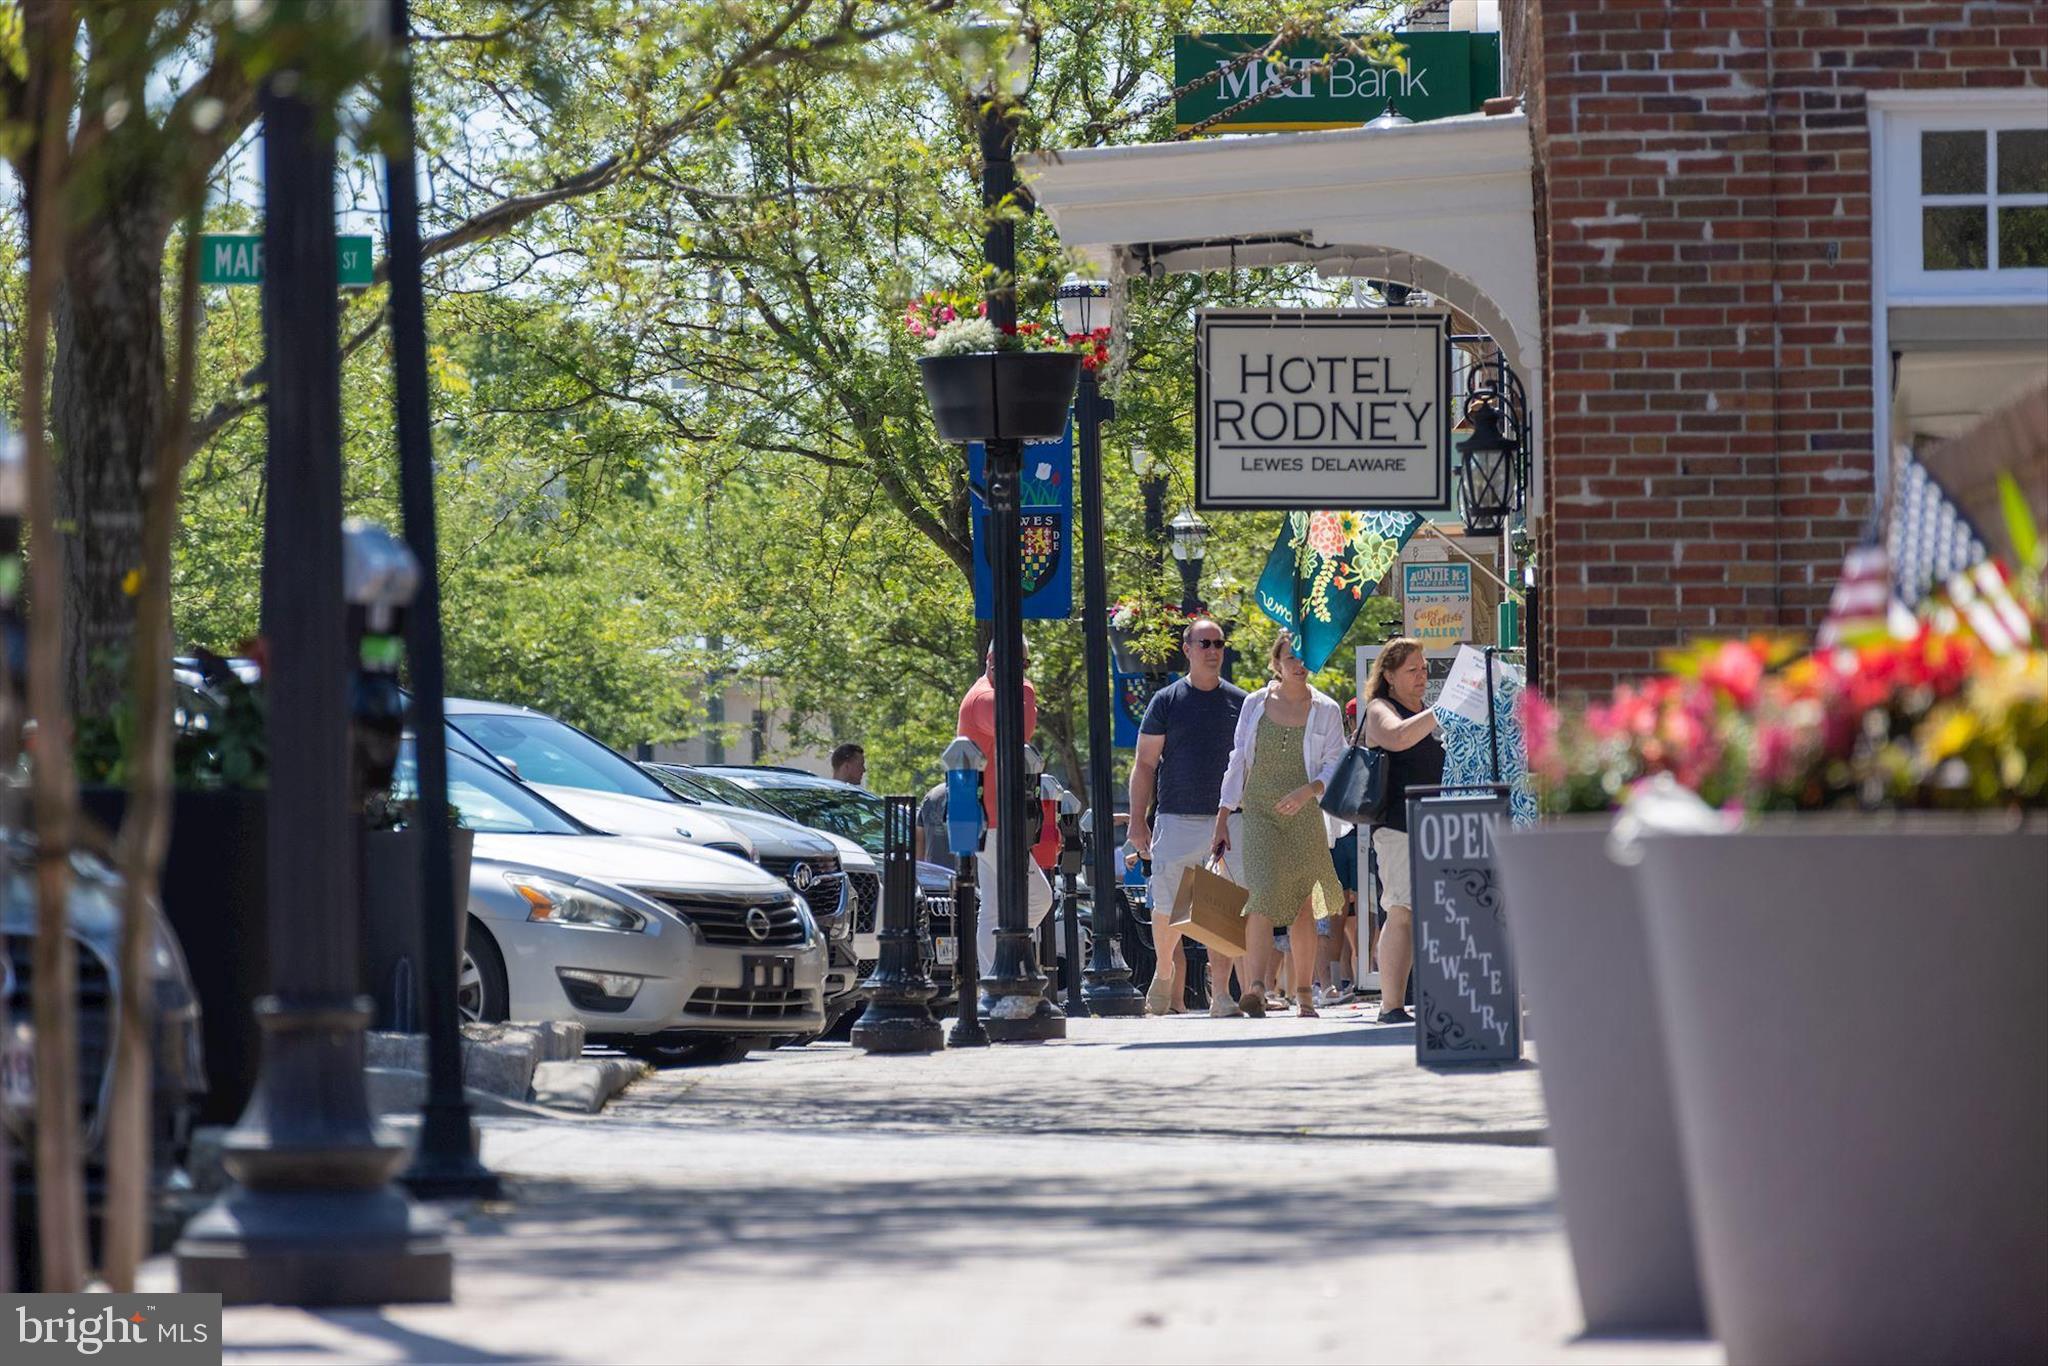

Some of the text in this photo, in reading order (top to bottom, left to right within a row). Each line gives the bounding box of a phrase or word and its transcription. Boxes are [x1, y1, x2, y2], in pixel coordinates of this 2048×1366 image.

[1216, 57, 1429, 100] M&T Bank
[214, 243, 358, 277] MAR ST
[1239, 353, 1411, 394] HOTEL
[1213, 400, 1433, 441] RODNEY
[1020, 516, 1054, 527] WES
[1409, 567, 1449, 581] AUNTIE
[1413, 627, 1465, 638] GALLERY
[1419, 812, 1501, 861] OPEN
[1434, 880, 1503, 995] ESTATE
[1421, 921, 1509, 1046] JEWELRY
